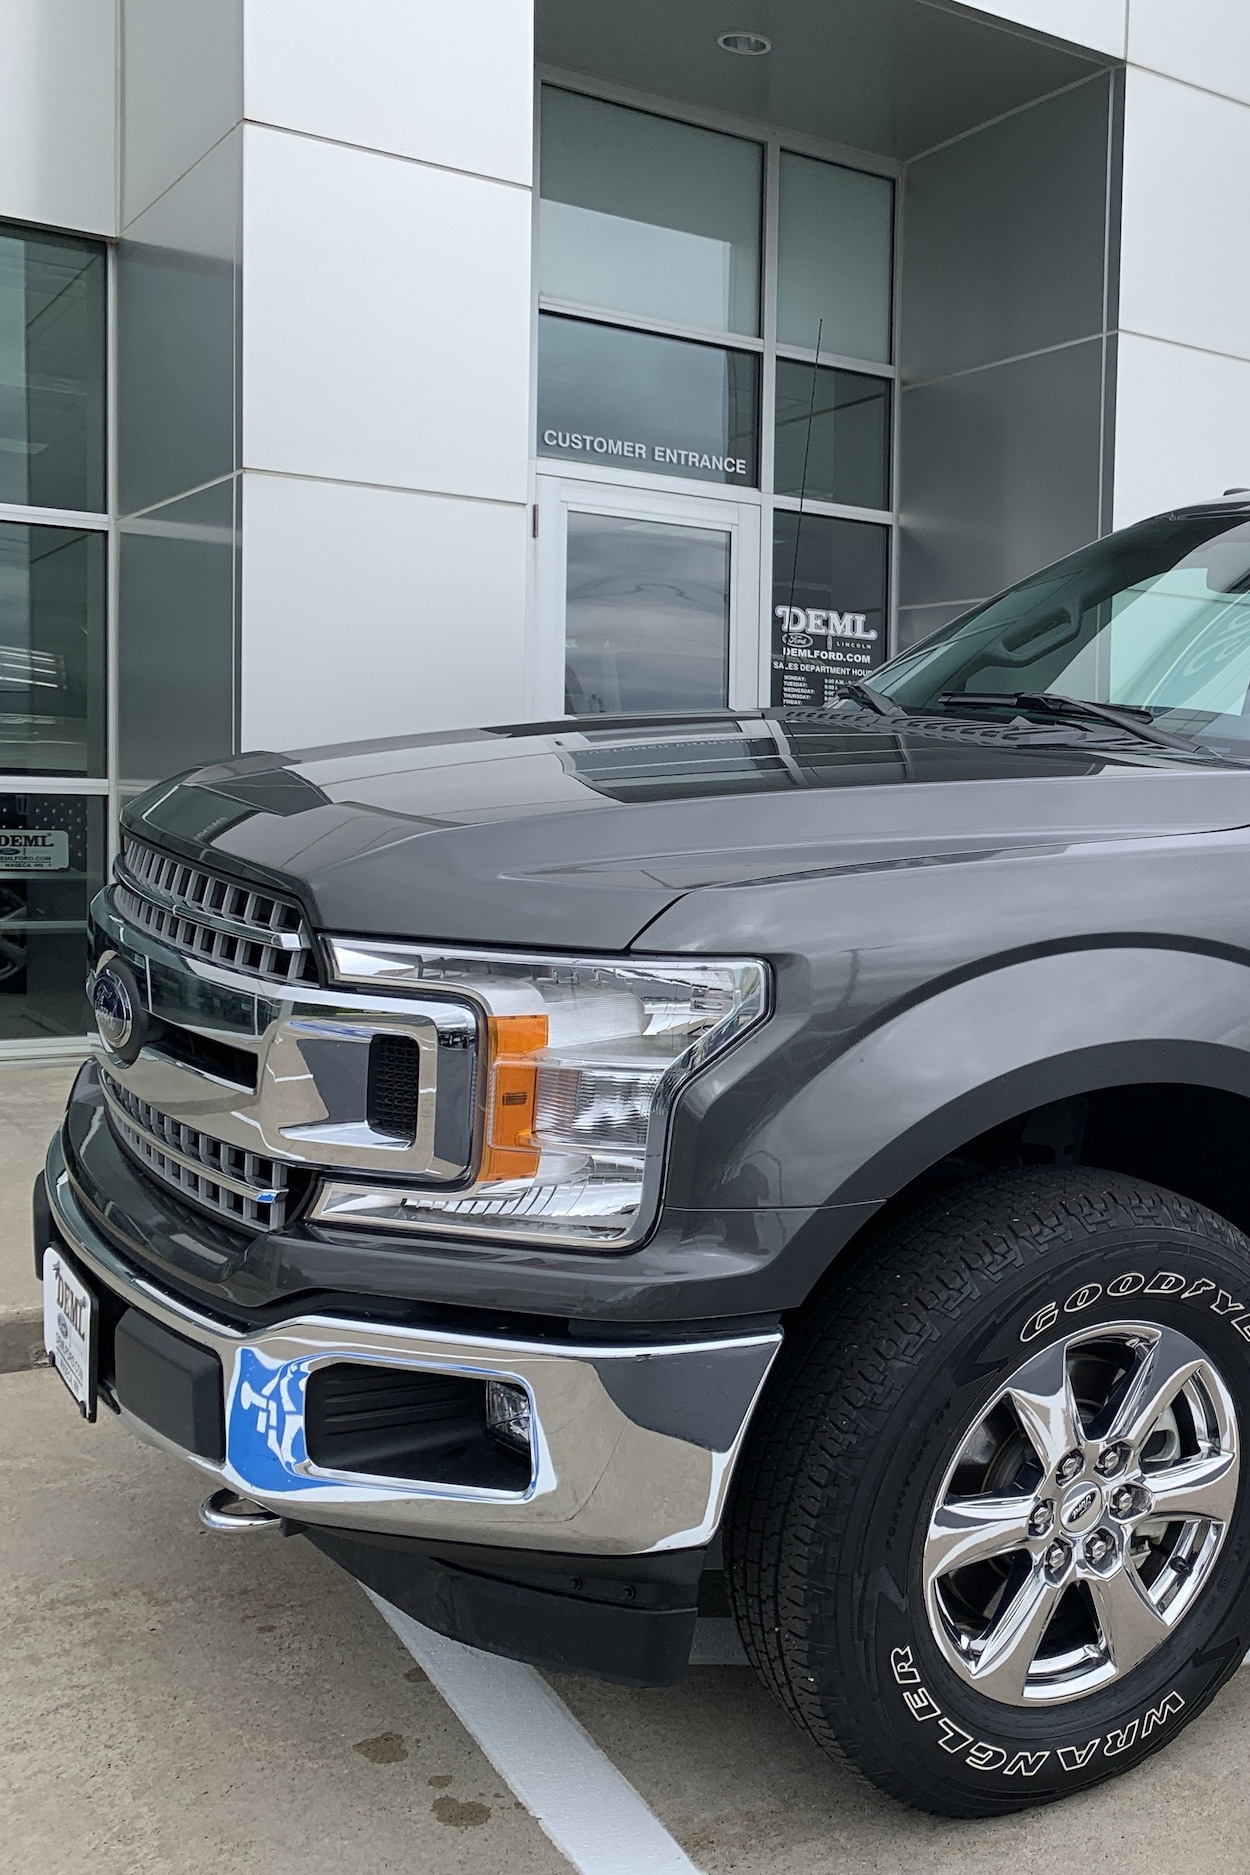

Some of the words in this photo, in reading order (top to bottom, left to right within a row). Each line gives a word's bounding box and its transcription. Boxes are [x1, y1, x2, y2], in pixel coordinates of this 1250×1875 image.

[543, 429, 646, 460] CUSTOMER
[654, 446, 747, 475] ENTRANCE
[775, 605, 878, 640] DEML
[837, 641, 872, 650] LINCOLN
[783, 646, 871, 664] DEMLFORD.COM
[800, 663, 851, 676] DEPARTMENT
[852, 668, 873, 676] HOU
[783, 680, 808, 688] TUESDAY:
[783, 686, 816, 695] WEDNESDAY:
[783, 692, 812, 700] THURSDAY:
[783, 698, 803, 706] FRIDAY:
[0, 835, 54, 848] DEML
[890, 1645, 1186, 1777] WRANGLER
